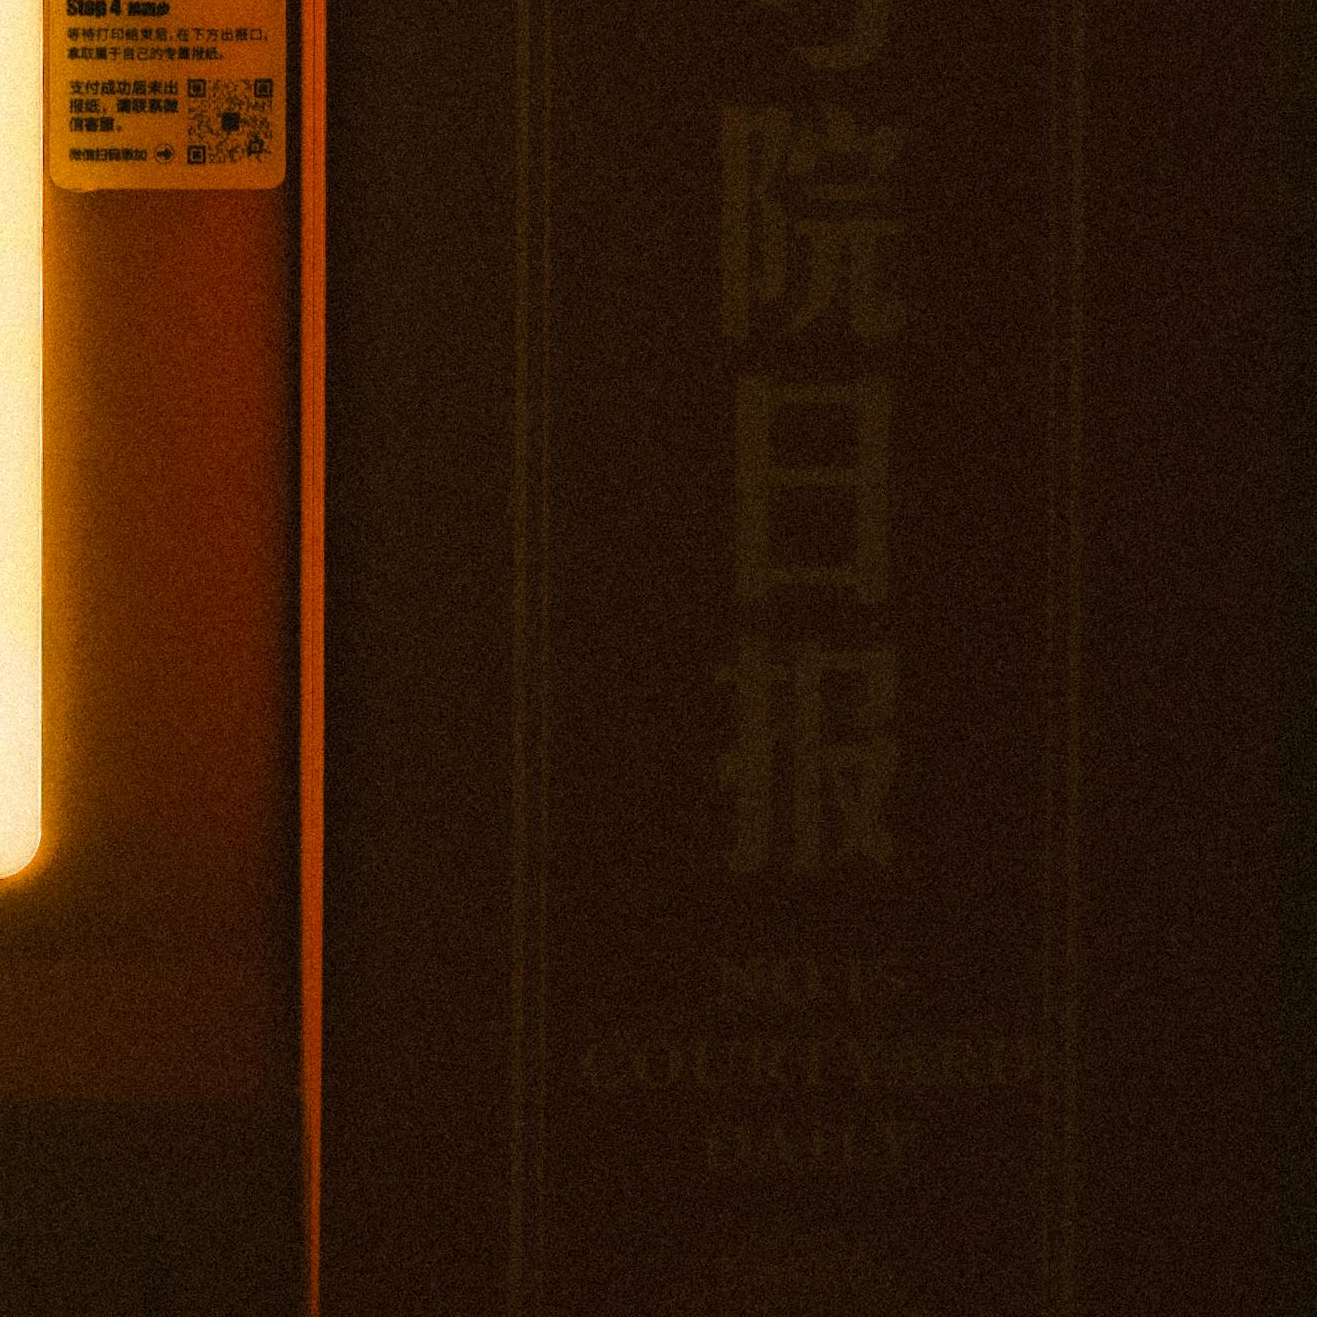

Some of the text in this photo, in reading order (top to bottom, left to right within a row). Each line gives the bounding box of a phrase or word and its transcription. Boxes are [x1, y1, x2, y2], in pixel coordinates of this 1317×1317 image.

[128, 1, 170, 16] 第四步
[578, 1038, 1036, 1090] COURTYARD
[704, 1121, 918, 1173] DAILY
